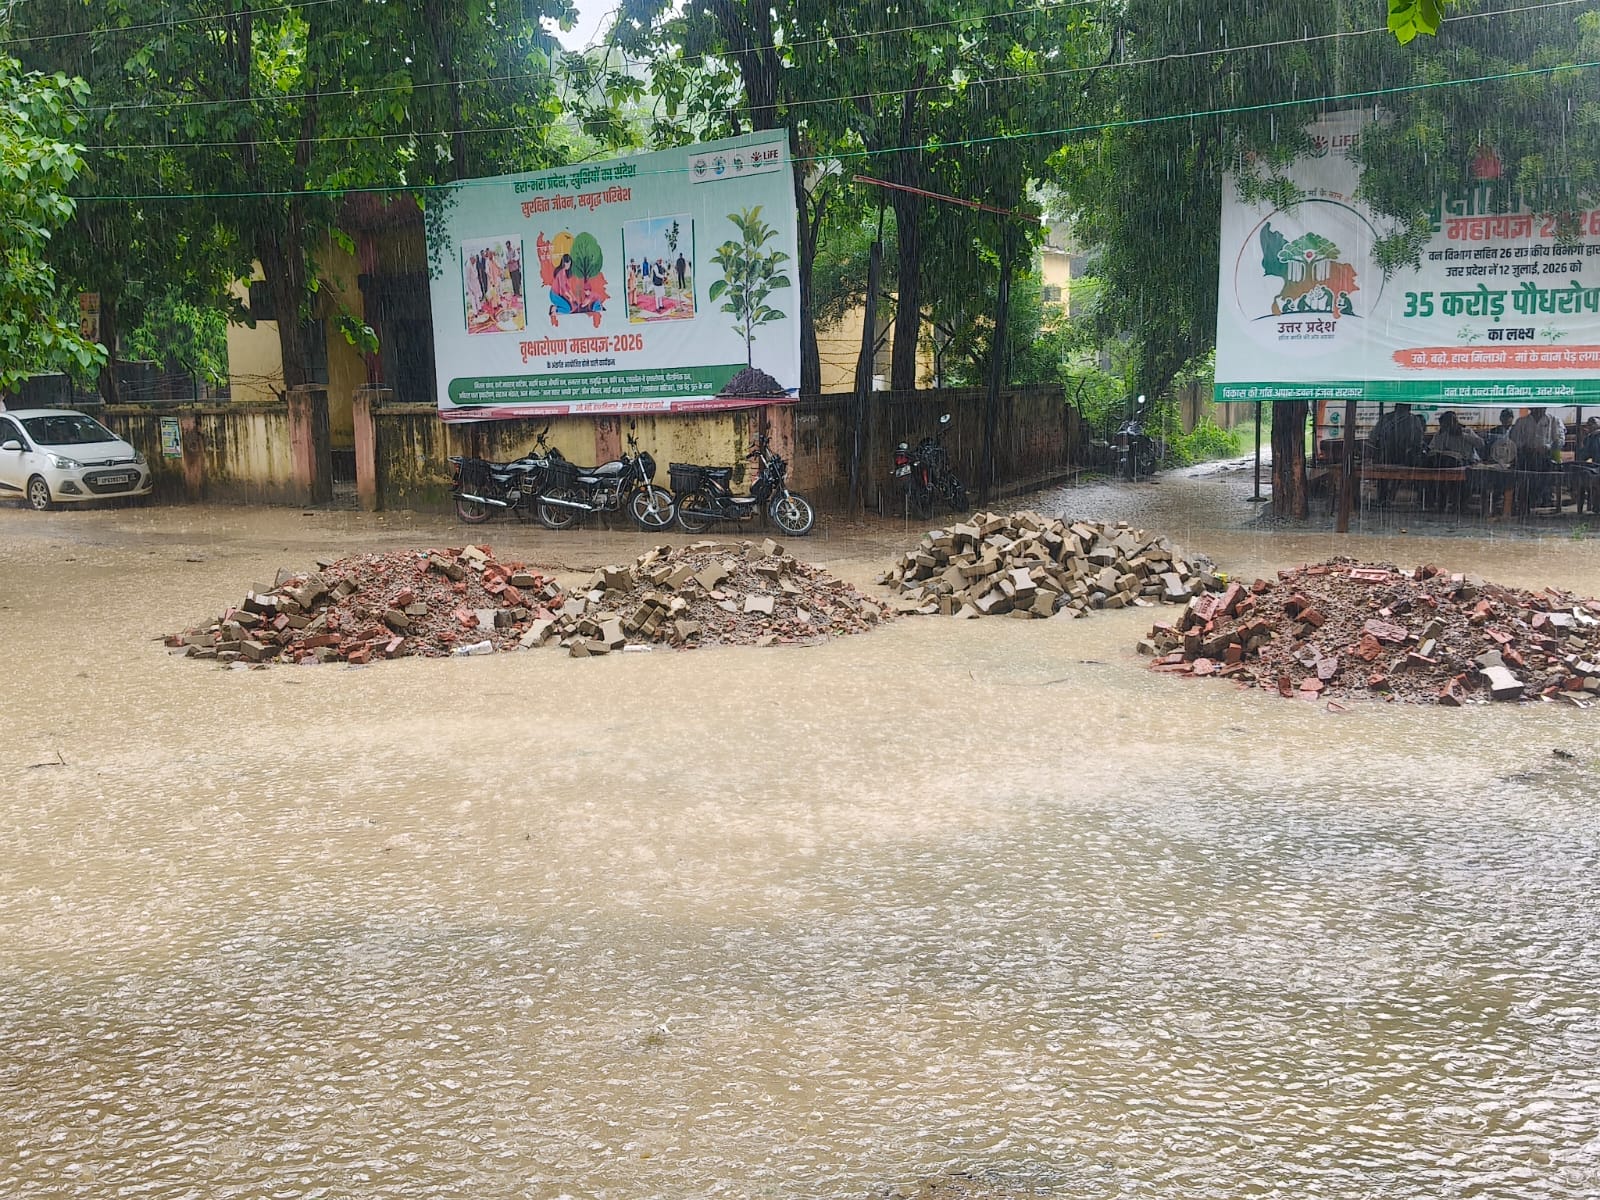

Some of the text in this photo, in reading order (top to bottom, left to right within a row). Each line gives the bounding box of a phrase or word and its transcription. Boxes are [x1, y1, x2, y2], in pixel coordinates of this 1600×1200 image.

[763, 150, 778, 160] LiFE
[547, 173, 568, 190] प्रदेश,
[570, 166, 600, 190] खुशियों
[601, 168, 612, 181] का
[614, 162, 636, 178] संदेश
[521, 185, 632, 218] सुरक्षित जीवन, समृद्ध परिवेश
[1446, 210, 1600, 240] महायज्ञ 26
[1428, 250, 1442, 261] वन
[1445, 248, 1471, 262] विभाग
[1474, 247, 1498, 260] सहित
[1500, 248, 1511, 258] 26
[1552, 242, 1584, 256] विभागों
[1586, 244, 1600, 257] द्वार
[1446, 260, 1583, 278] उत्तर प्रदेश में 12 जुलाई, 2026 को
[1404, 280, 1600, 322] 35 करोड़ पौधरोप
[1277, 318, 1336, 333] उत्तर प्रदेश
[1488, 328, 1536, 340] का लक्ष्य
[520, 334, 644, 364] वृक्षारोपण महायज्ञ-2026
[1411, 352, 1428, 365] उठो,
[1451, 352, 1469, 364] हाथ
[1471, 350, 1508, 364] मिलाओ
[1530, 350, 1538, 362] के
[1540, 352, 1562, 362] नाम
[1564, 350, 1576, 364] पेड़
[1578, 351, 1600, 362] लगा
[1222, 386, 1246, 398] विकास
[1248, 386, 1257, 398] की
[1260, 386, 1272, 398] गति
[1315, 387, 1334, 397] इंजन
[1336, 388, 1363, 397] सरकार
[1444, 384, 1574, 397] वन एवं वन्यजीव विभाग, उत्तर प्रदेश
